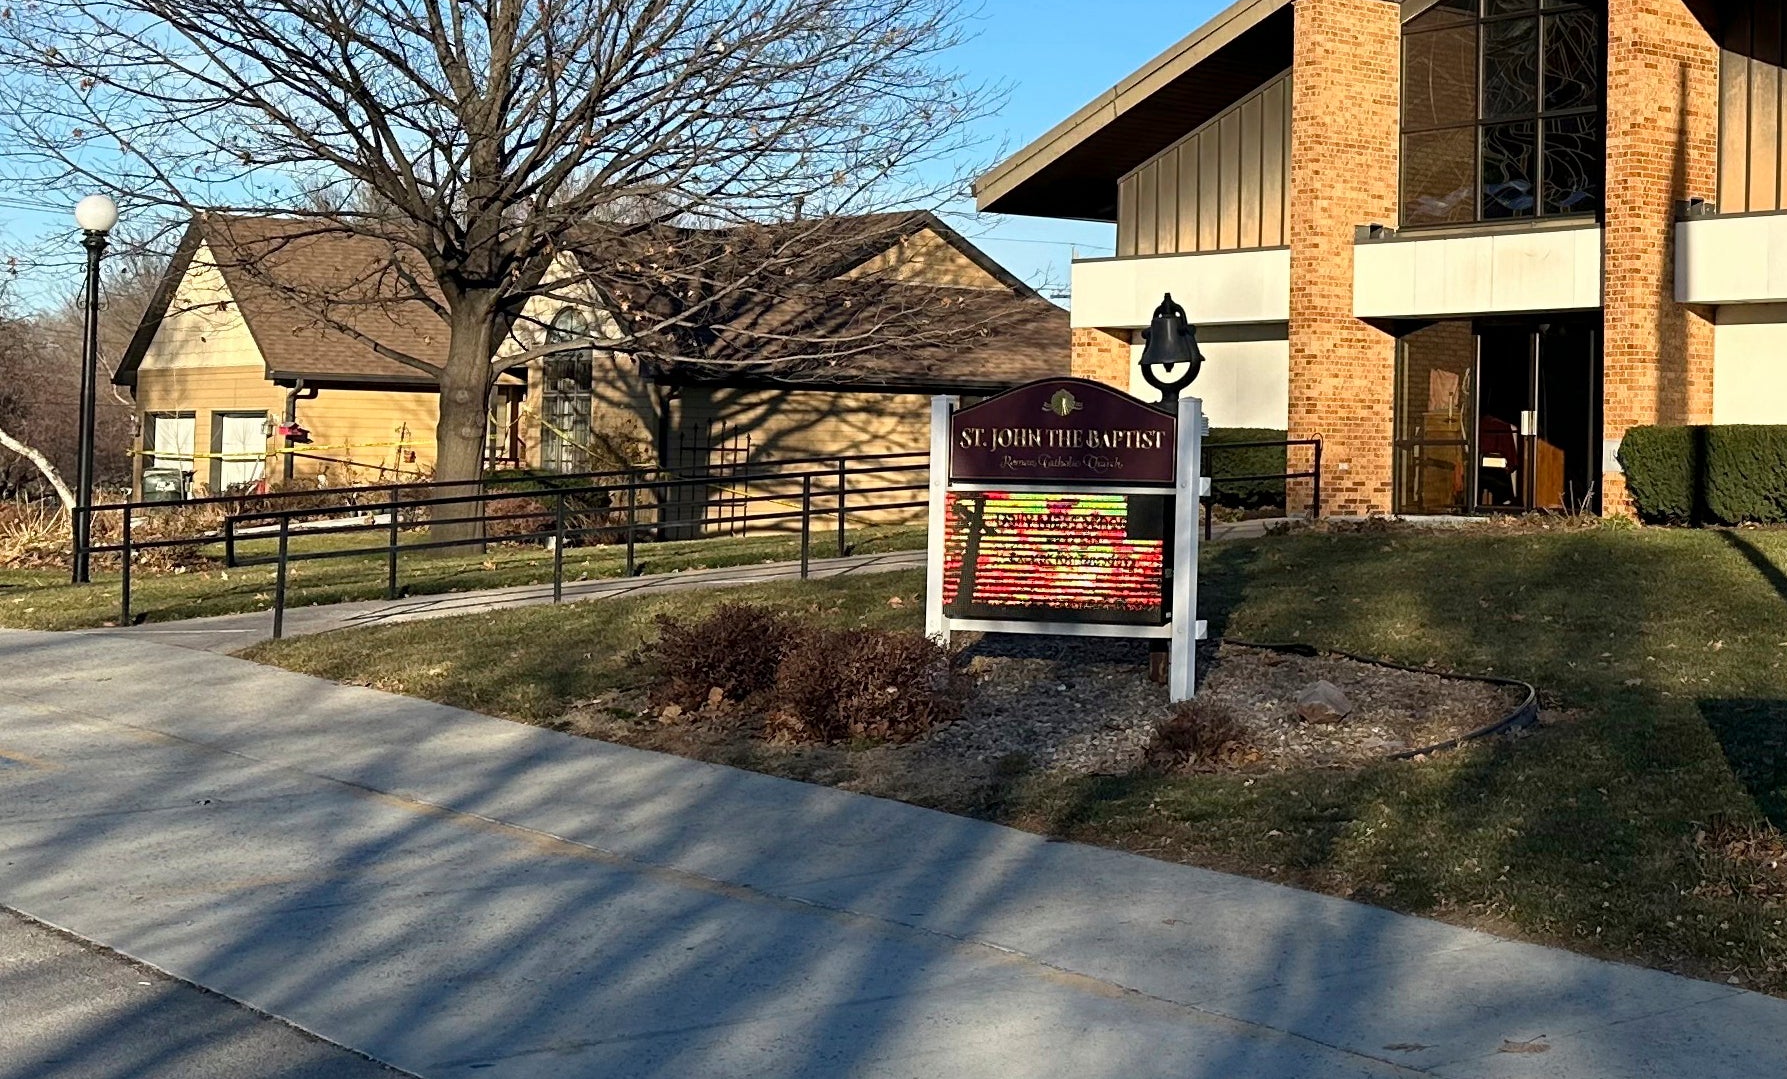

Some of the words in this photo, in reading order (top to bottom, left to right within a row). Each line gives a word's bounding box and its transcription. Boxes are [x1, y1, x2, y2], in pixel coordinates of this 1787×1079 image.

[960, 428, 987, 449] ST.
[991, 428, 1041, 452] JOHN
[1045, 429, 1083, 449] THE
[1086, 429, 1166, 450] BAPTIST
